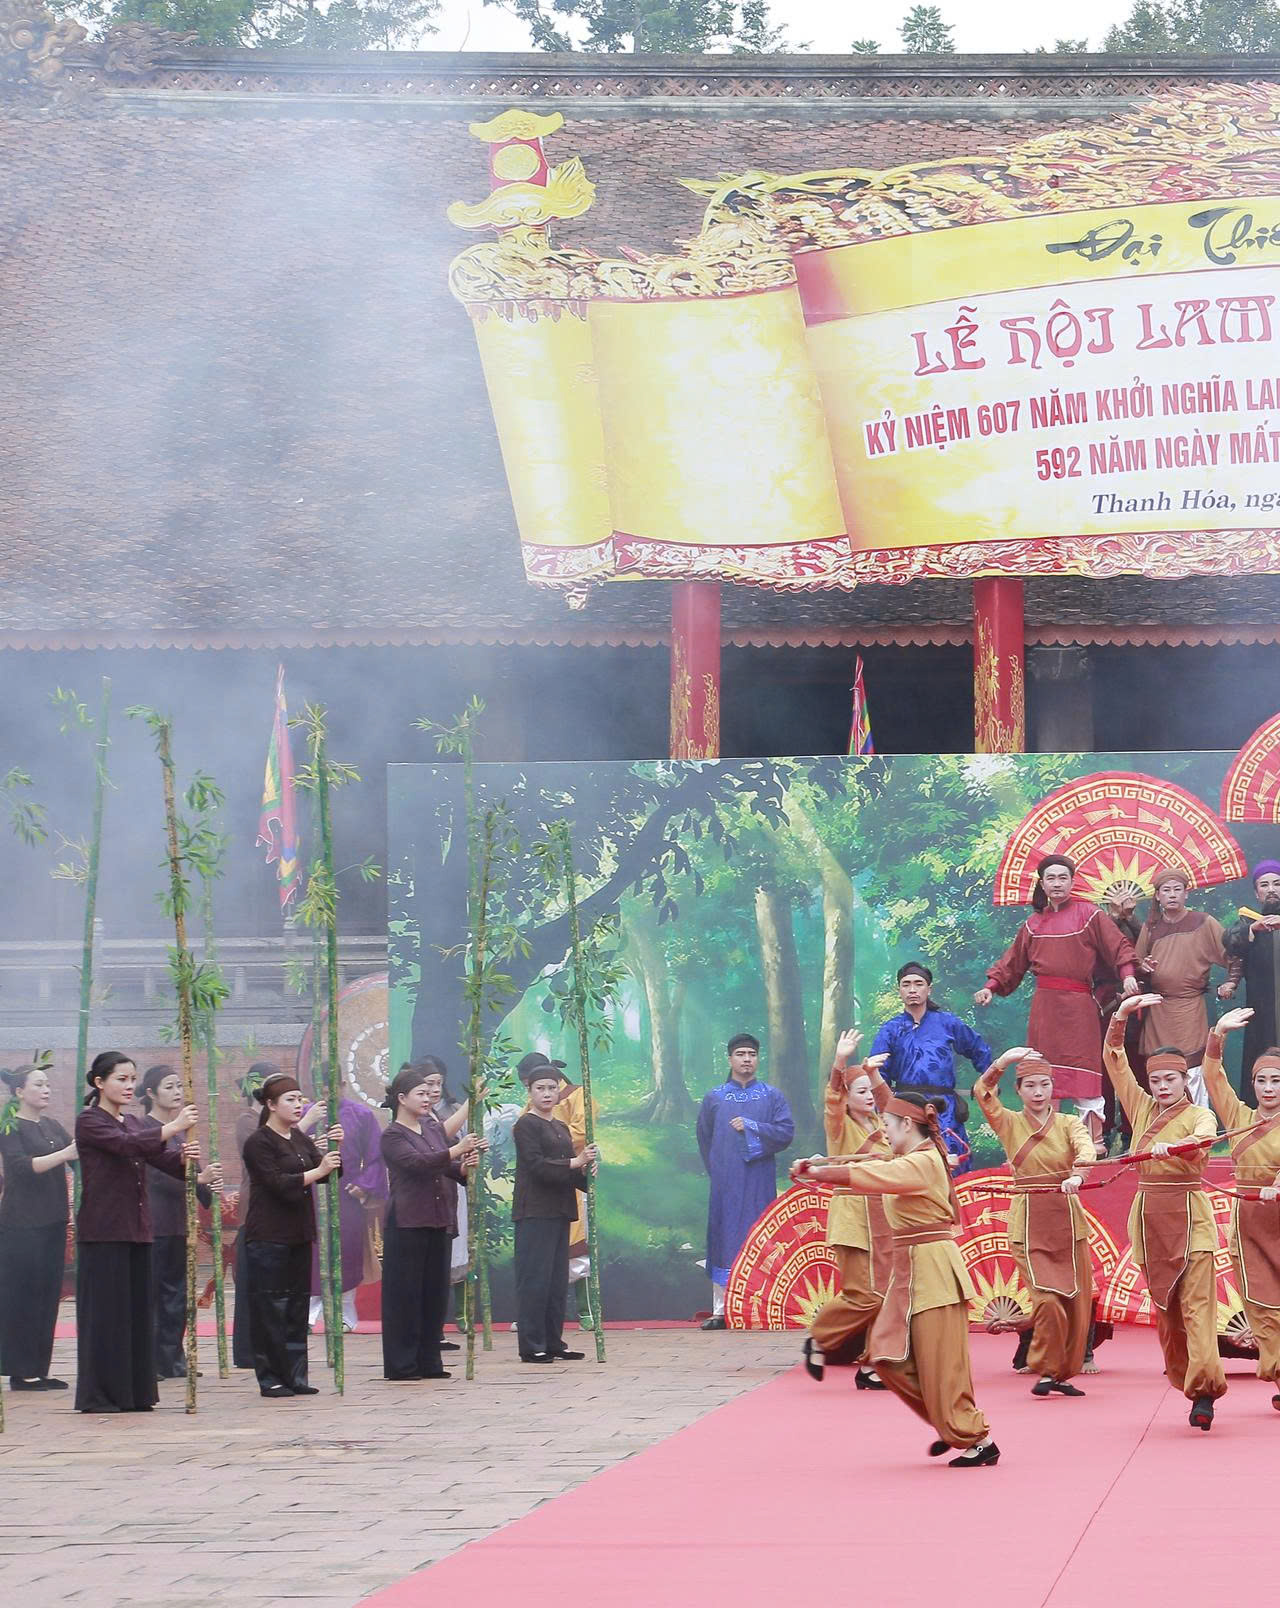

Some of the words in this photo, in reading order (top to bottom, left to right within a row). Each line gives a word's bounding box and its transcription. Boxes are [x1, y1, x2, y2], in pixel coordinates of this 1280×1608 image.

[1045, 219, 1161, 267] Đại
[911, 305, 986, 377] LỄ
[1000, 298, 1115, 369] HỘI
[1136, 295, 1276, 350] LAM
[866, 409, 896, 456] KỶ
[905, 404, 971, 451] NIỆM
[977, 401, 1021, 437] 607
[1030, 387, 1088, 429] NĂM
[1096, 375, 1154, 422] KHỞI
[1162, 375, 1238, 415] NGHĨA
[1036, 446, 1082, 481] 592
[1089, 435, 1147, 475] NĂM
[1156, 428, 1221, 469] NGÀY
[1092, 492, 1171, 515] Thanh
[1181, 488, 1237, 513] Hóa,
